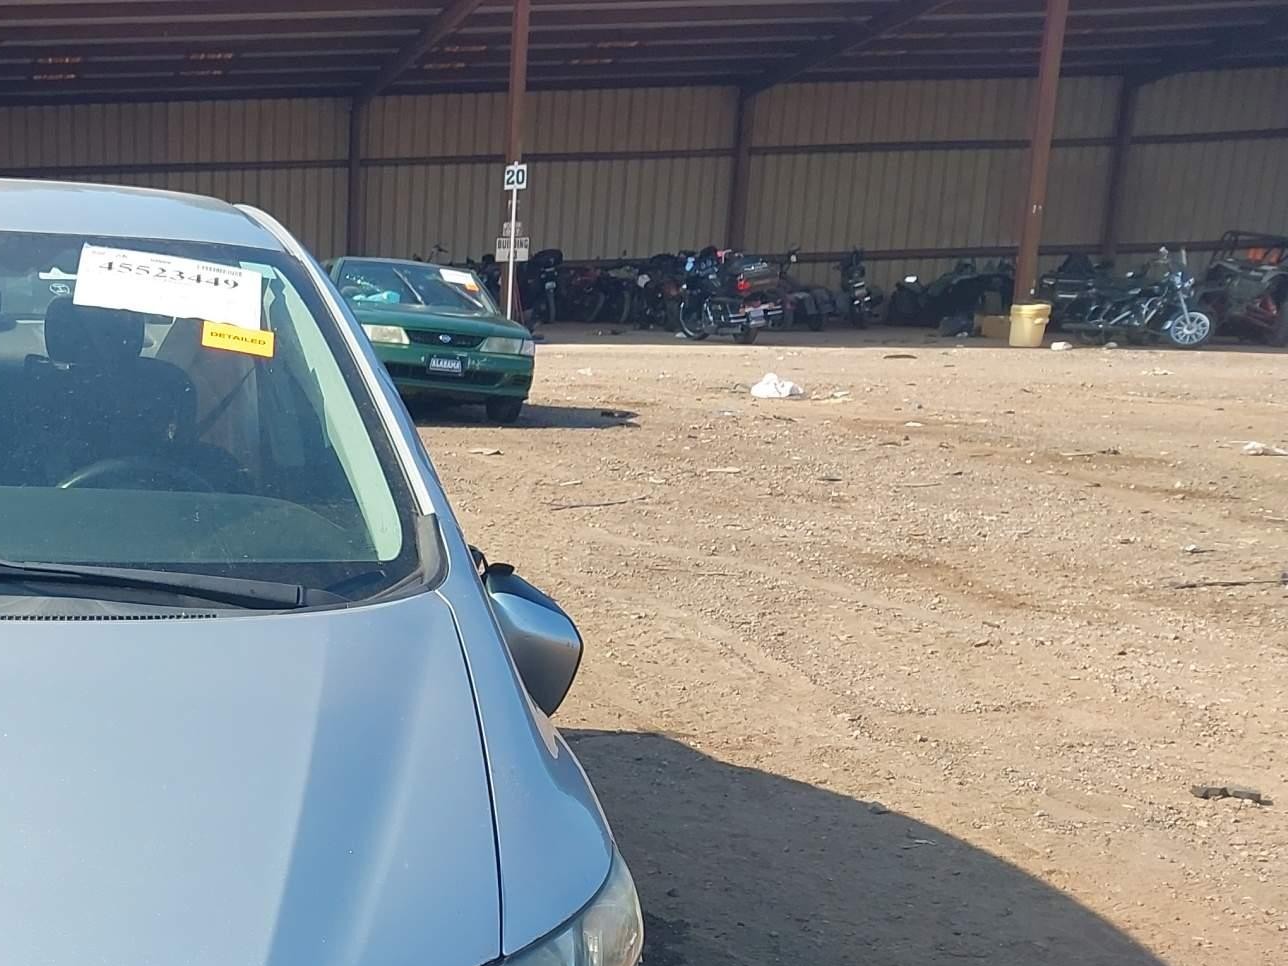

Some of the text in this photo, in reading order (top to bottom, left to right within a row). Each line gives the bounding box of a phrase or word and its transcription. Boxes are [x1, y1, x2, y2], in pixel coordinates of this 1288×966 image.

[506, 169, 525, 185] 20
[497, 239, 529, 249] BUIDING
[99, 261, 239, 289] 45523449
[210, 331, 266, 346] DETAILED
